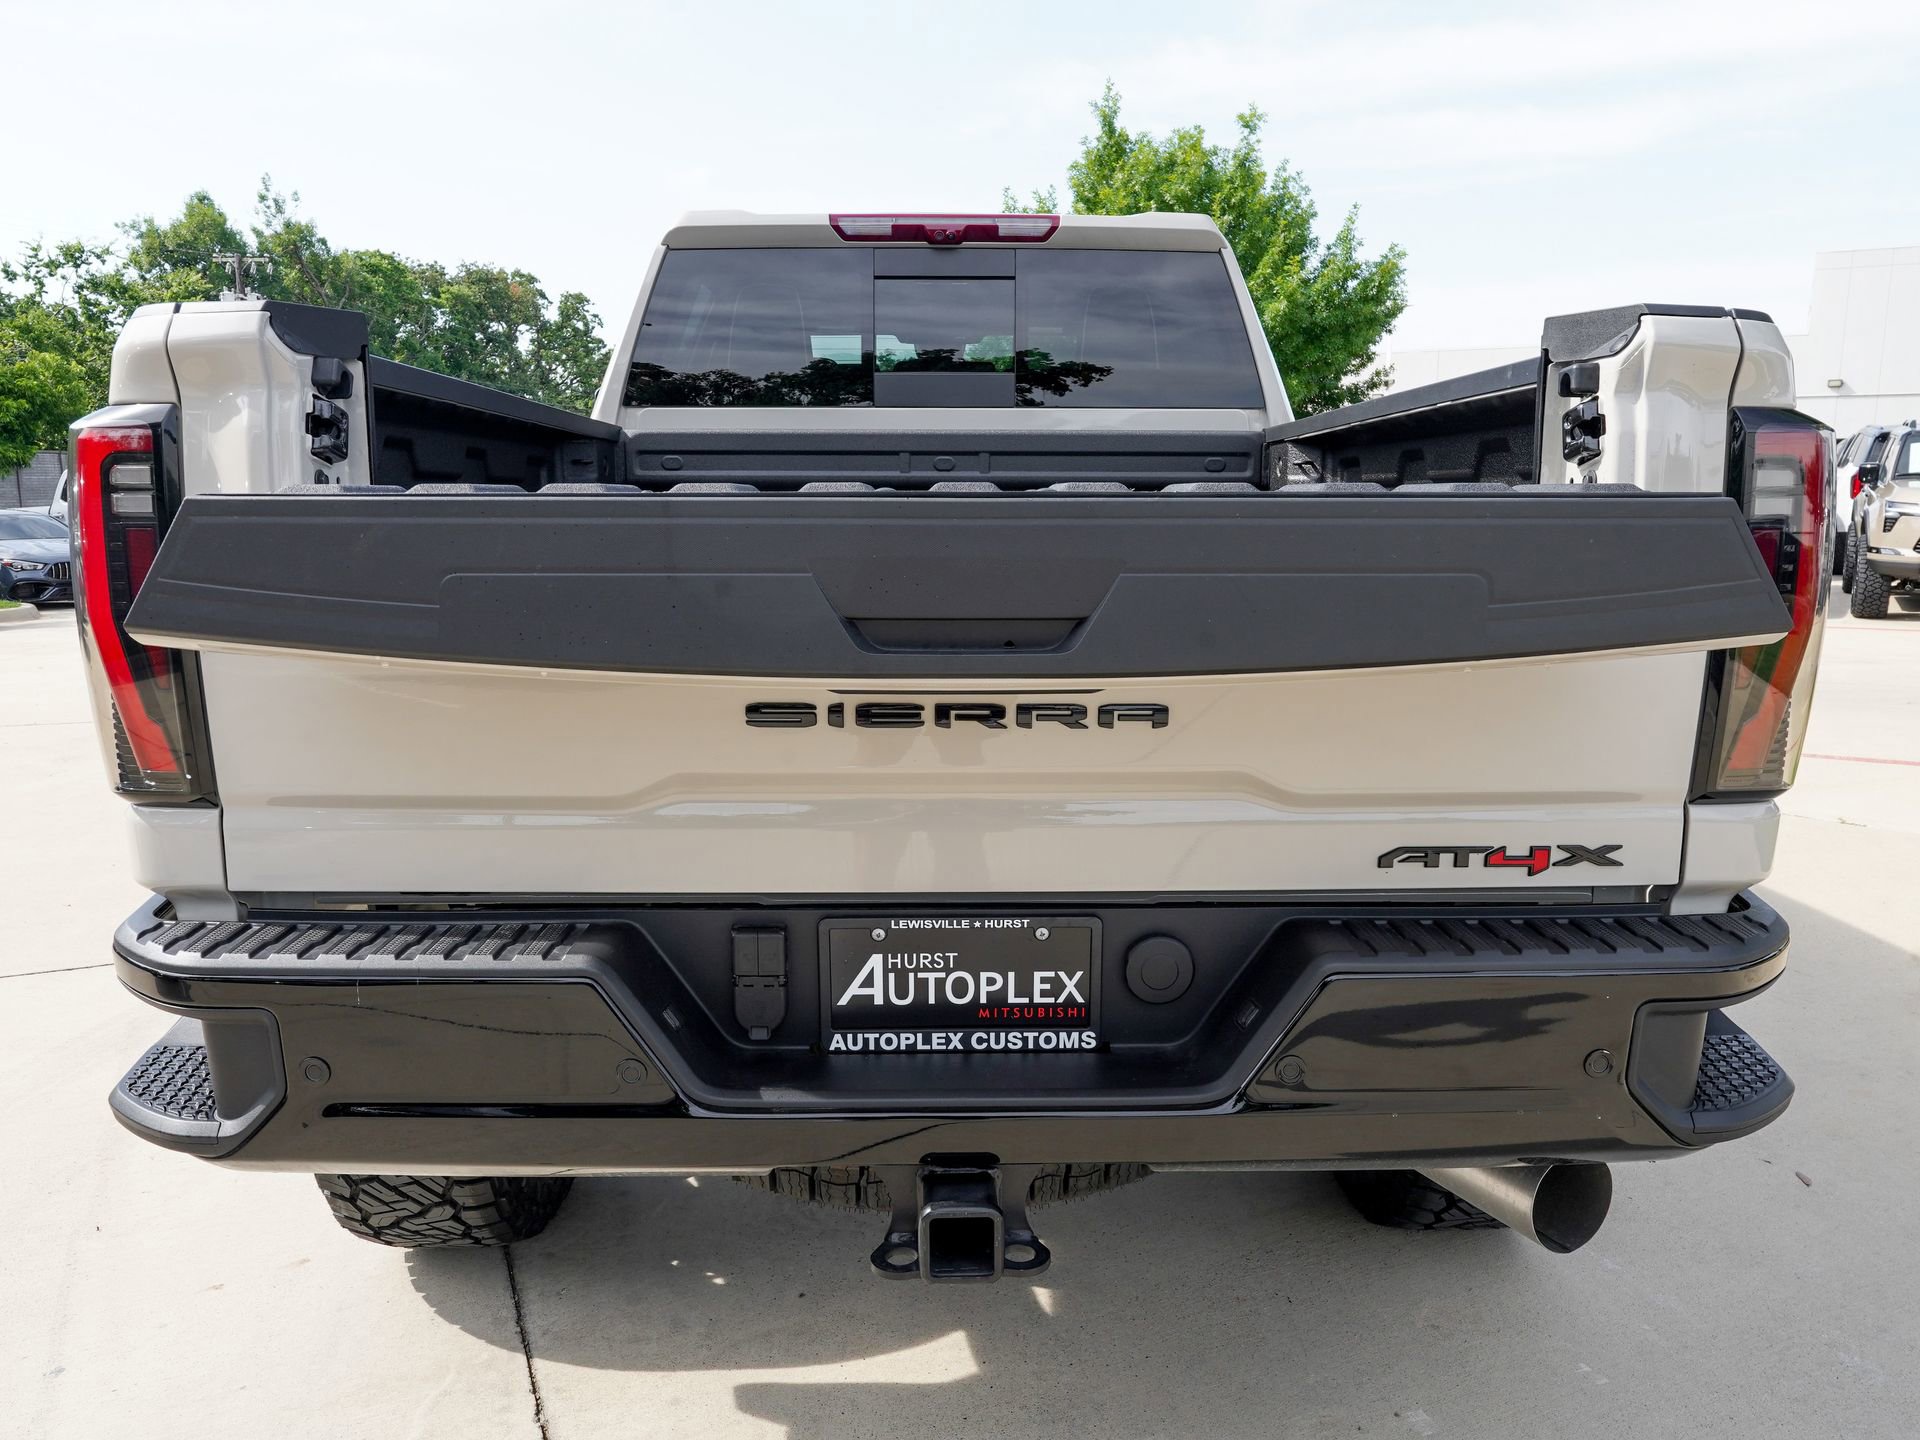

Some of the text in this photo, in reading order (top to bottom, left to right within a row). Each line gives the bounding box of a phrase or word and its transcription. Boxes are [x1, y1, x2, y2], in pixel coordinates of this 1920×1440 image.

[745, 702, 1169, 729] SIERRA
[1377, 844, 1624, 877] AT4X
[891, 919, 1030, 929] LEWISVILLE HURST
[888, 953, 958, 969] HURST
[836, 953, 1086, 1006] AUTOPLEX
[978, 1007, 1086, 1018] MITSUBISHI
[828, 1031, 1097, 1051] AUTOPLEX CUSTOMS
